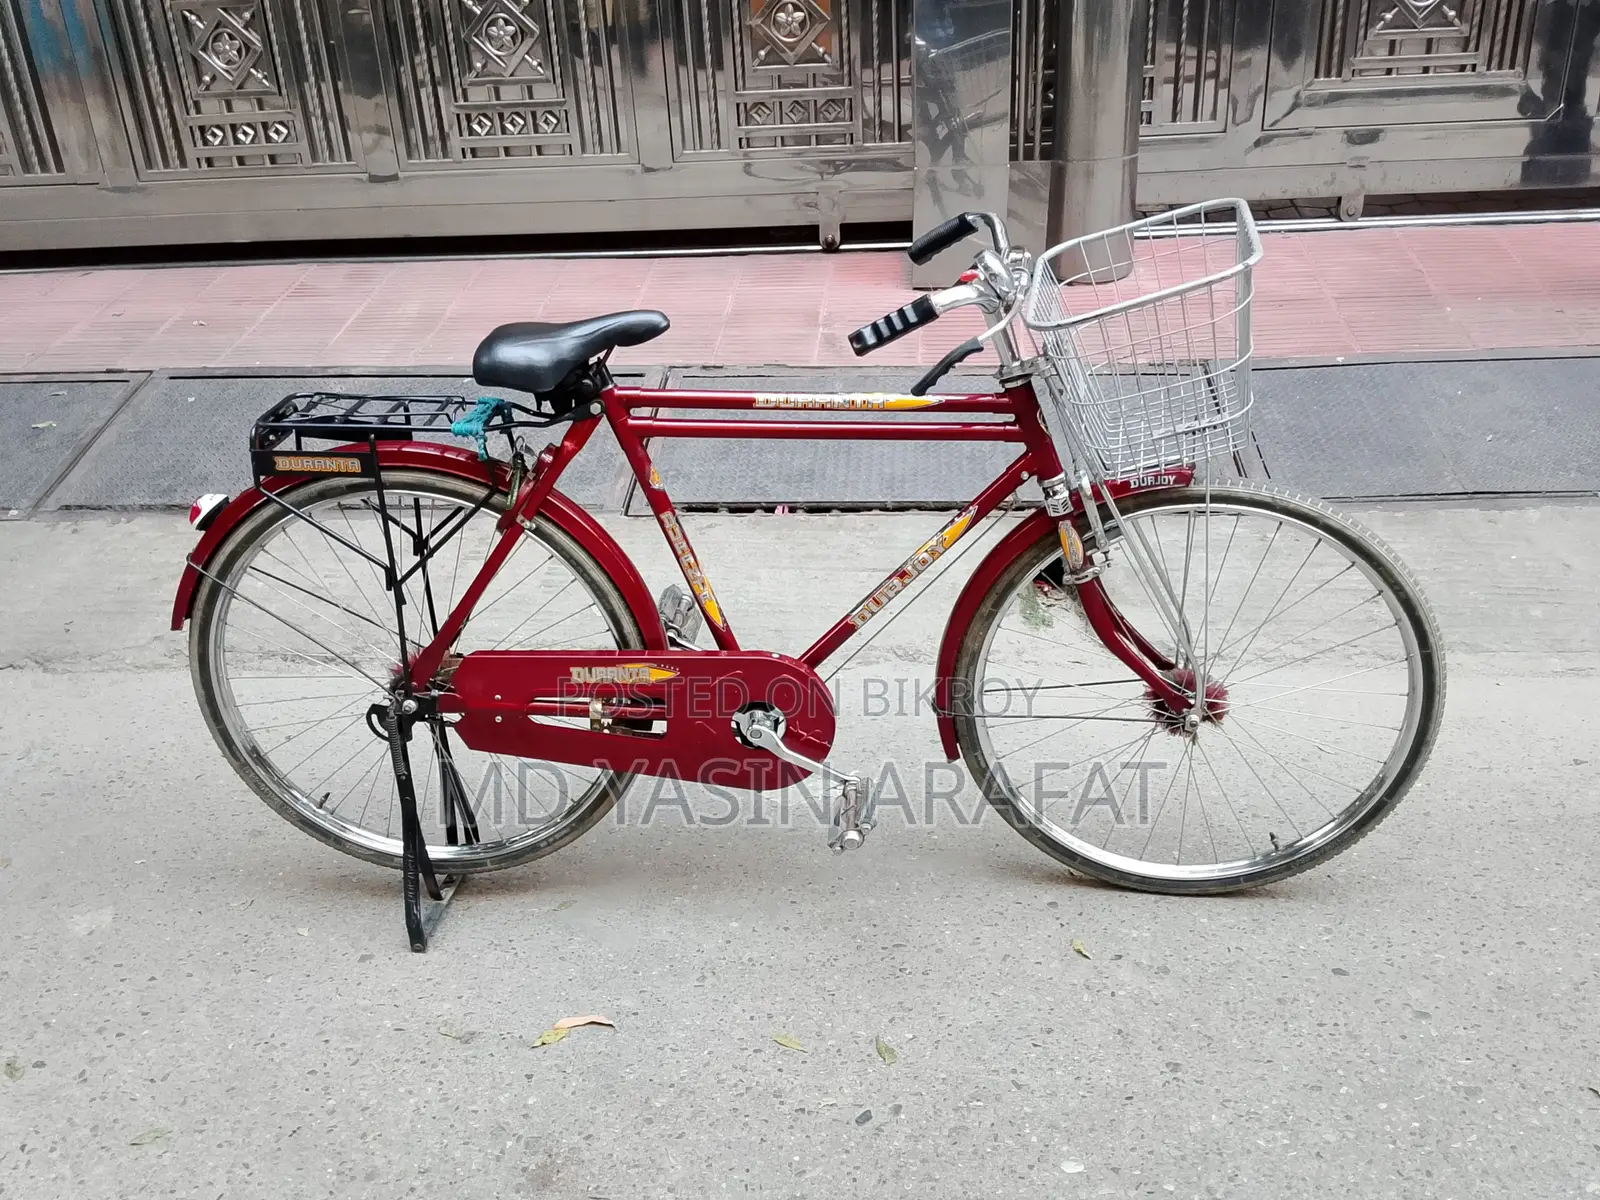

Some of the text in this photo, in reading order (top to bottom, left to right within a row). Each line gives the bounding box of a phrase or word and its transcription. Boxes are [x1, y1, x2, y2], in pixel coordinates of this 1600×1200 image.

[273, 455, 361, 472] DURANTA
[1130, 475, 1176, 488] DURJOY
[848, 536, 949, 629] DURJOY
[569, 666, 651, 683] DURANTA
